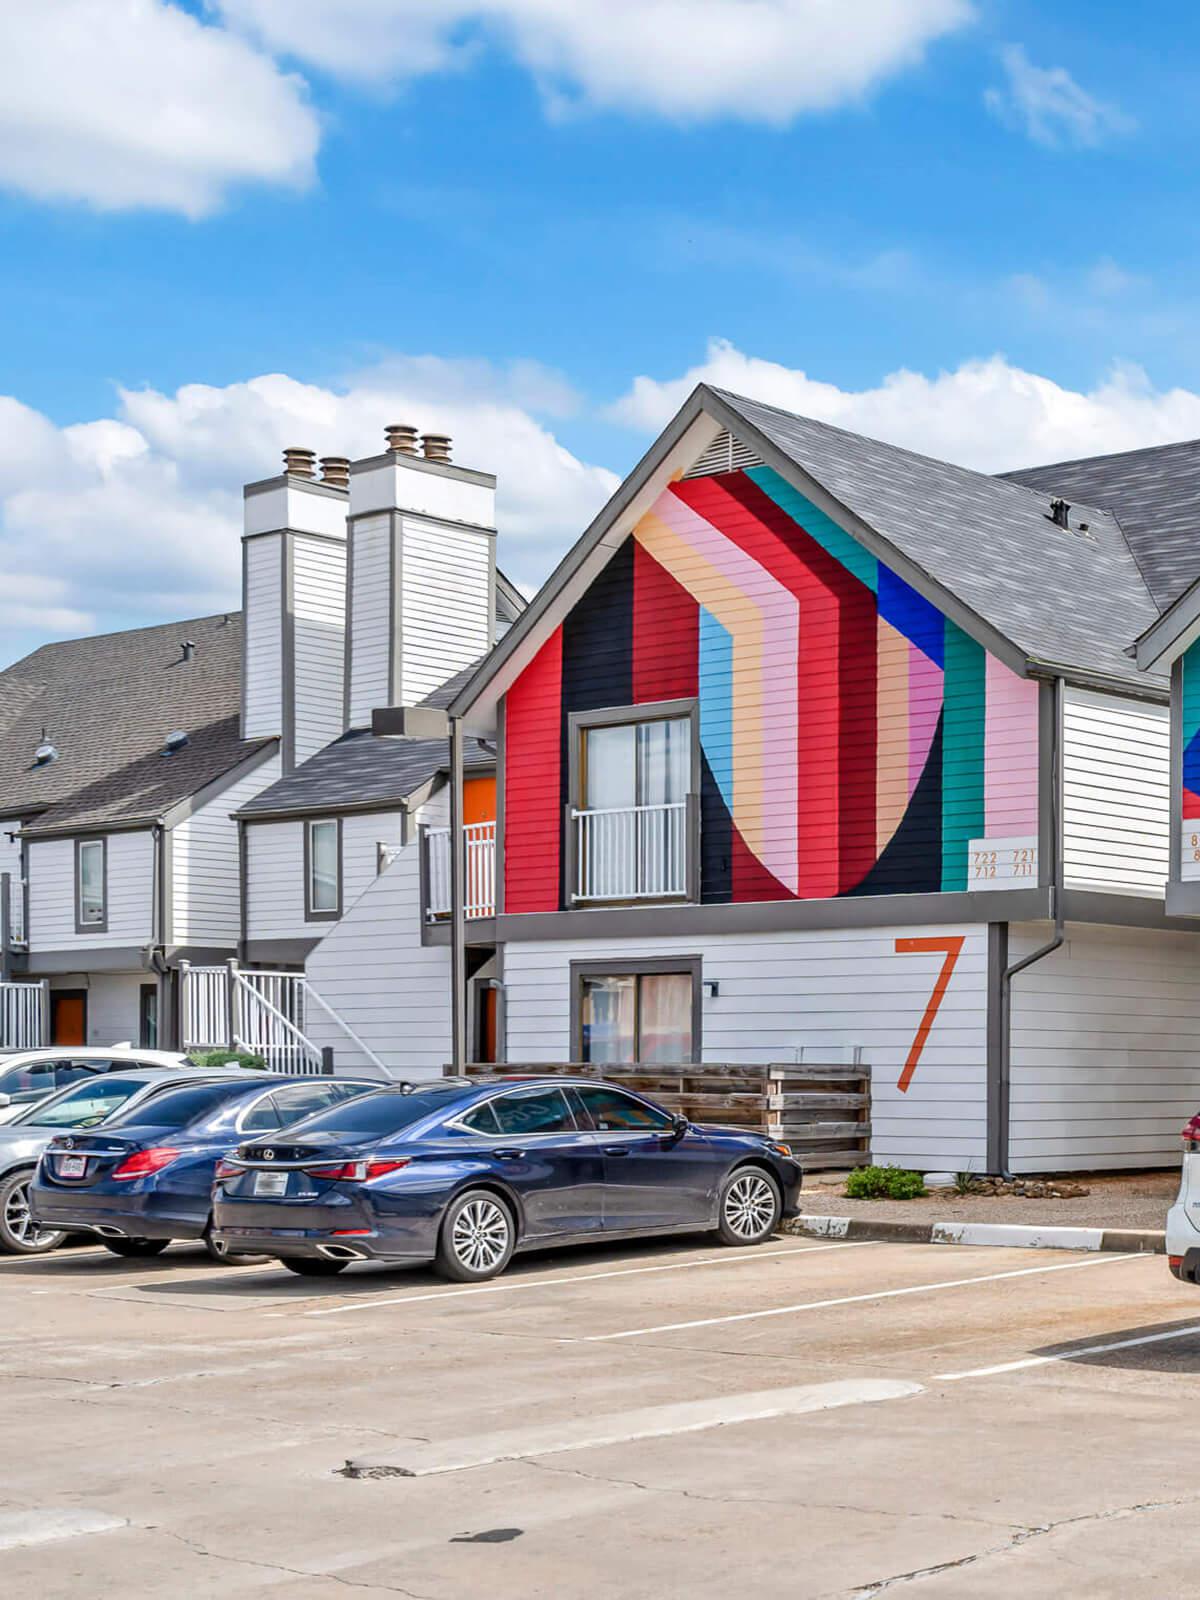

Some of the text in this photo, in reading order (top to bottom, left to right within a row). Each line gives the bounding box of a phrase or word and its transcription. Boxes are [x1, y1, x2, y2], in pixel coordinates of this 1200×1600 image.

[974, 848, 1035, 864] 722 721
[975, 864, 1032, 879] 712 711
[895, 936, 966, 1094] 7
